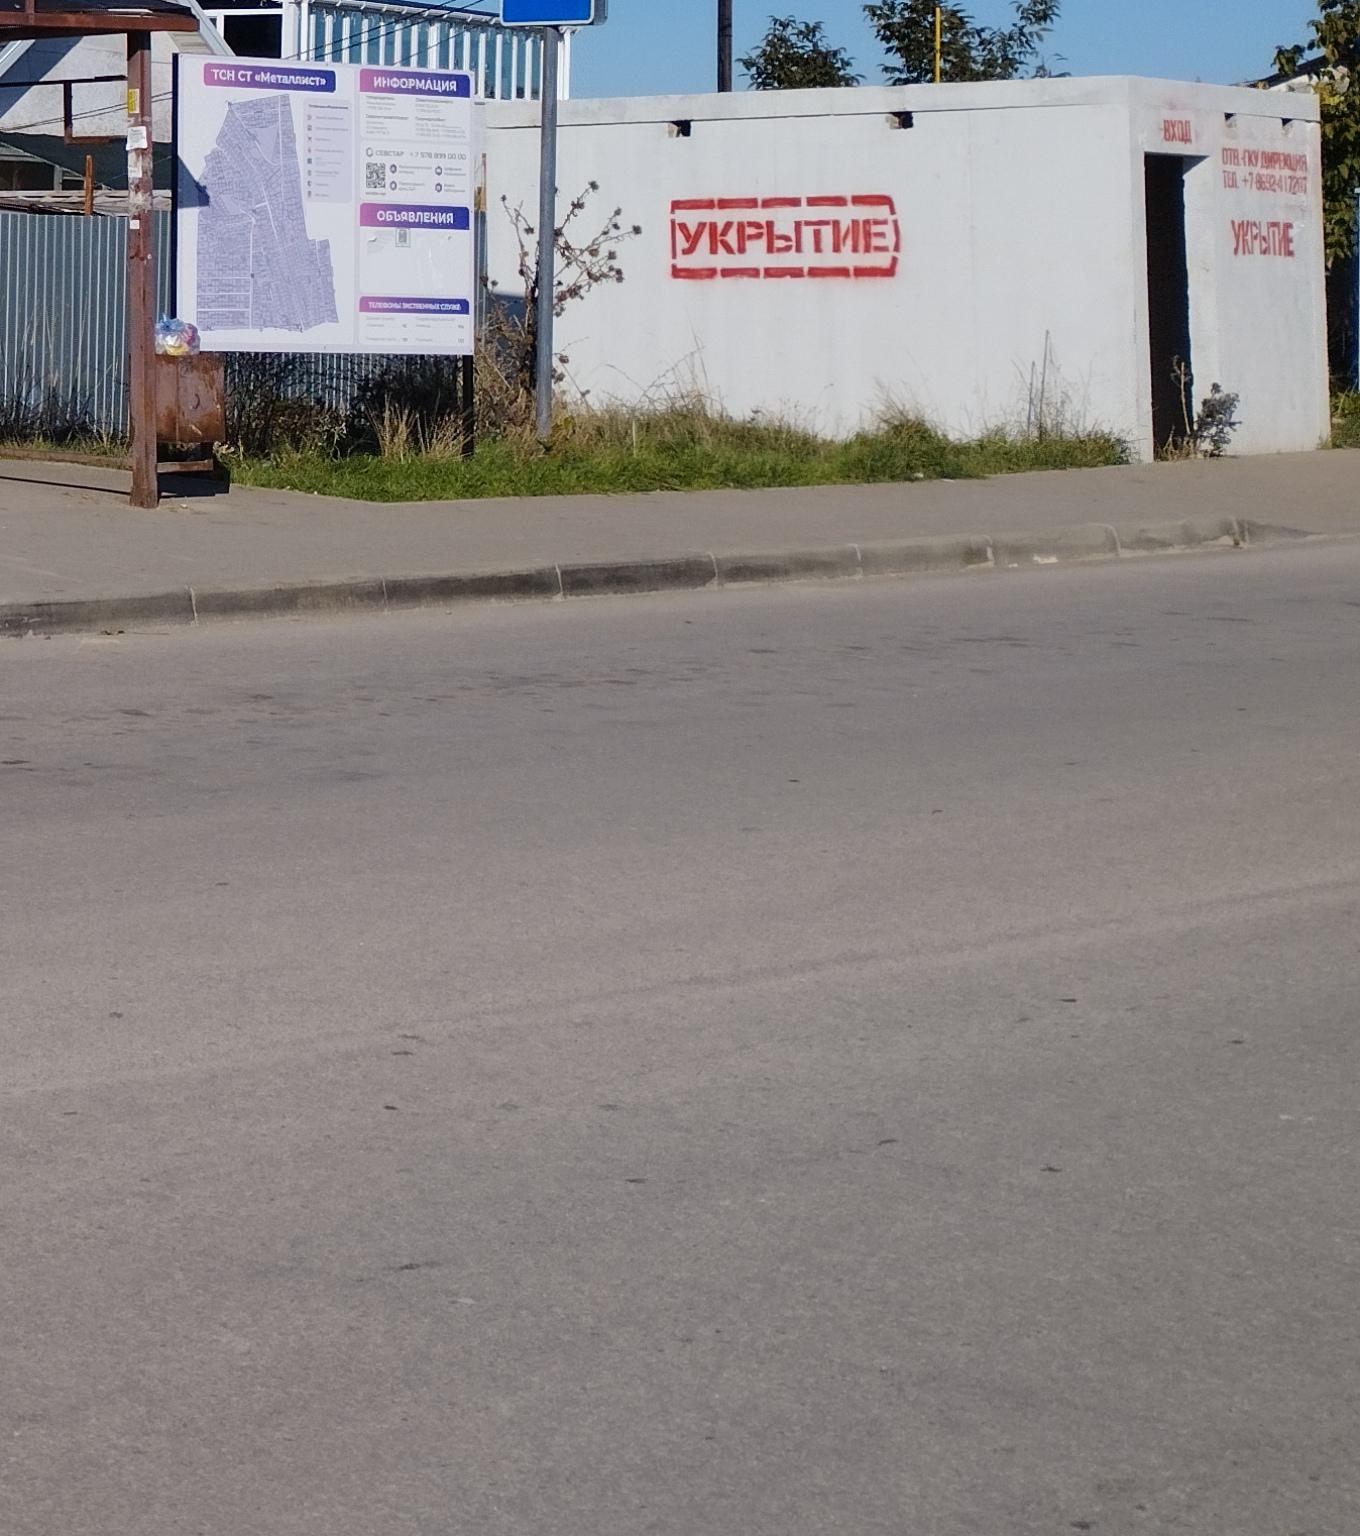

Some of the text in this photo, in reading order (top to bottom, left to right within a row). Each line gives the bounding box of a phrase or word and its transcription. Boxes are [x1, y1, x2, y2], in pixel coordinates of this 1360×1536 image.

[211, 69, 327, 87] ТСН СТ «Металлист»
[373, 76, 458, 93] ИНФОРМАЦИЯ
[1163, 119, 1193, 145] ВХОД
[376, 210, 455, 225] ОБЪЯВЛЕНИЯ
[677, 215, 891, 256] УКРЫТИЕ
[1230, 218, 1295, 258] УКРЫТИЕ
